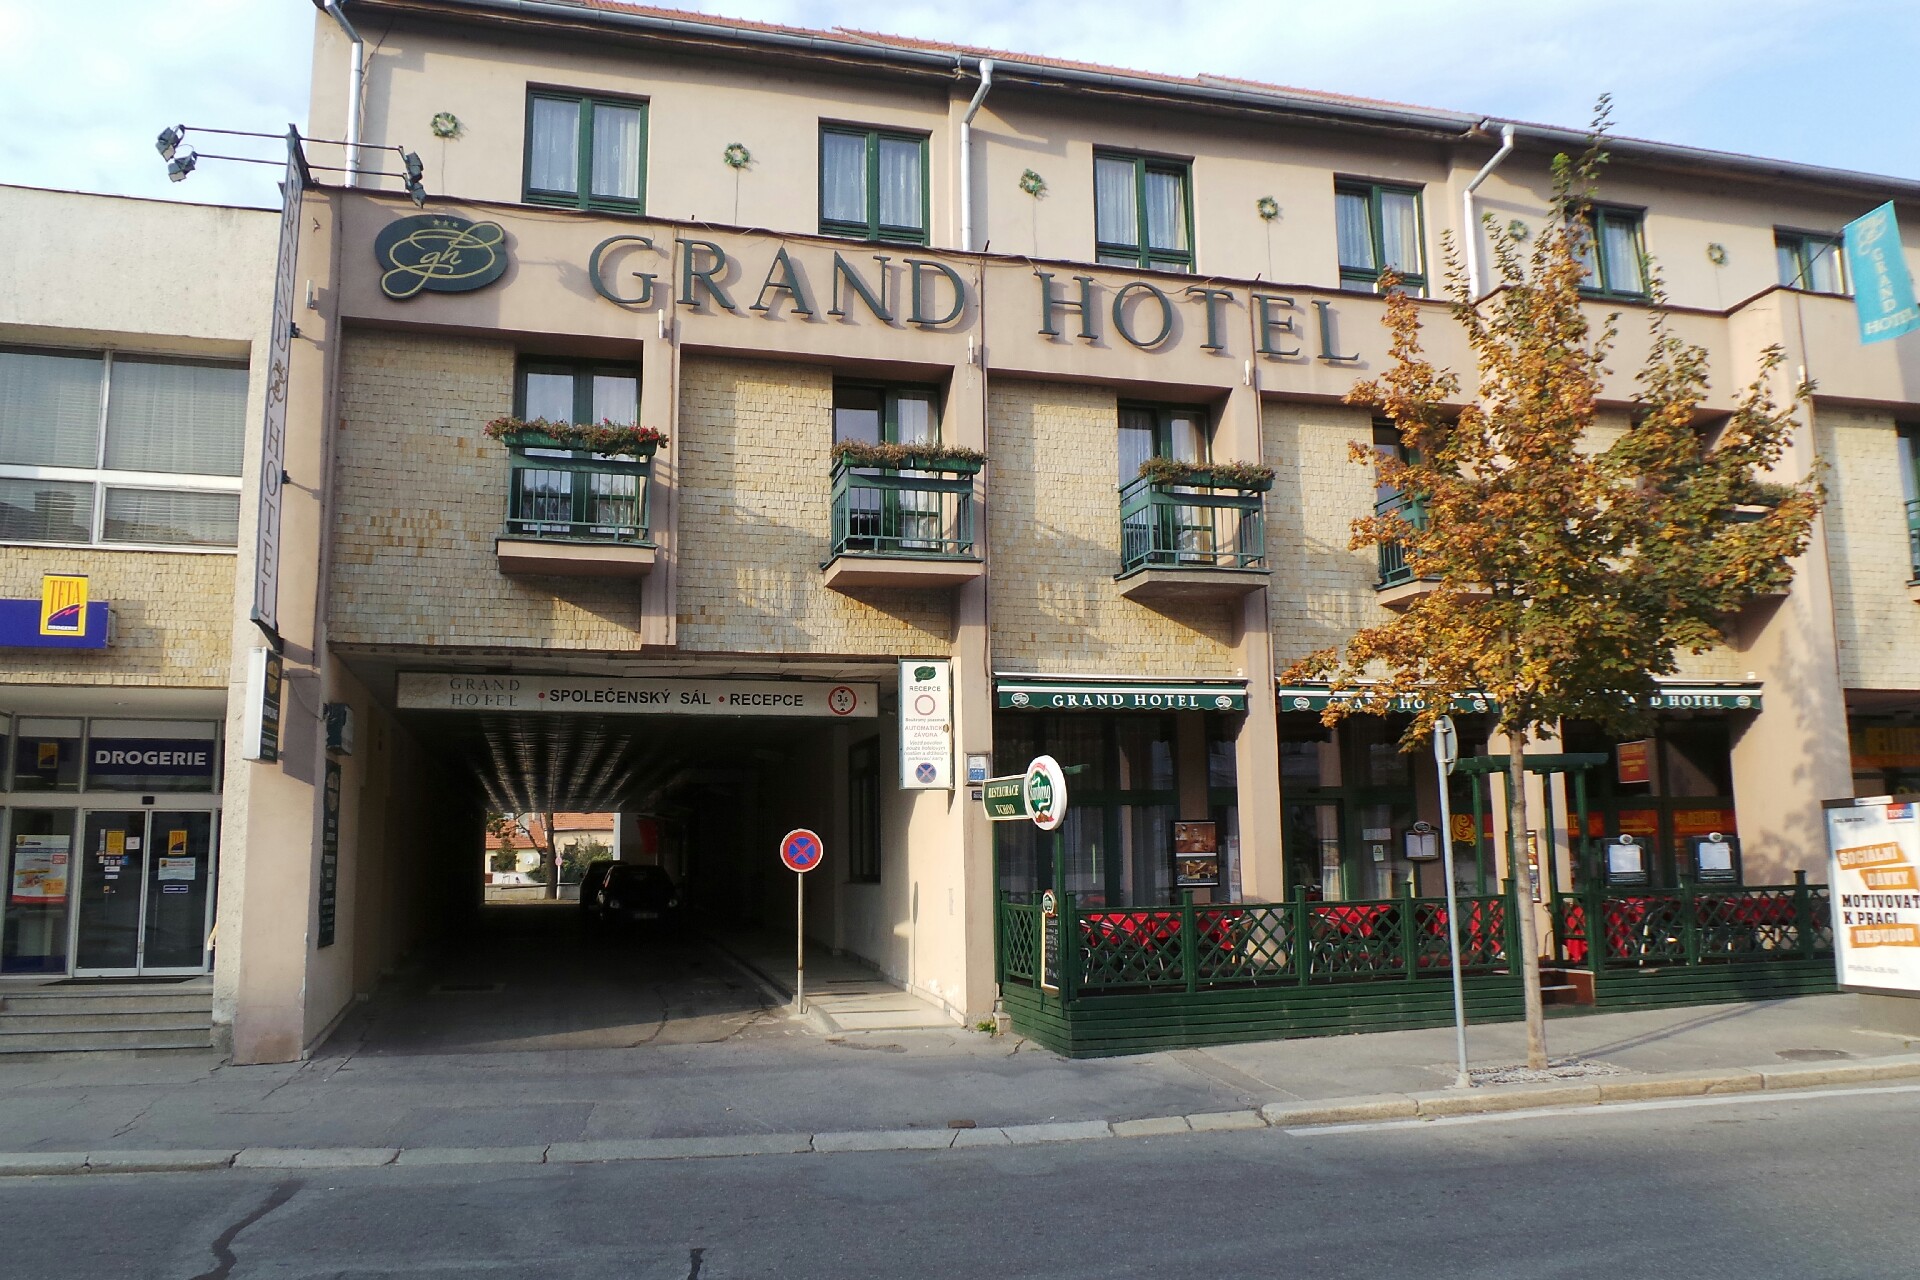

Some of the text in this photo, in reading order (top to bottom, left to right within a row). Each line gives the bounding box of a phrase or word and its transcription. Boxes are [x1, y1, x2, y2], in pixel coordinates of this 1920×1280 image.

[588, 234, 1360, 361] GRAND HOTEL
[50, 580, 80, 614] TETA
[450, 677, 520, 691] GRAND
[549, 687, 804, 707] SPOLEČENSKÝ SÁL RECEPCE
[1052, 694, 1199, 708] GRAND HOTEL
[1399, 698, 1458, 710] HOL
[1668, 695, 1722, 707] HOTEL
[95, 750, 207, 766] DROGERIE
[988, 784, 1020, 798] RESTAURACE
[1839, 843, 1898, 866] SOCIÁLNÍ
[1867, 870, 1909, 886] DÁVKY
[1842, 894, 1920, 909] MOTIVOVAT
[1844, 909, 1900, 925] K PRÁCI
[1856, 927, 1915, 944] NEBUDOU
